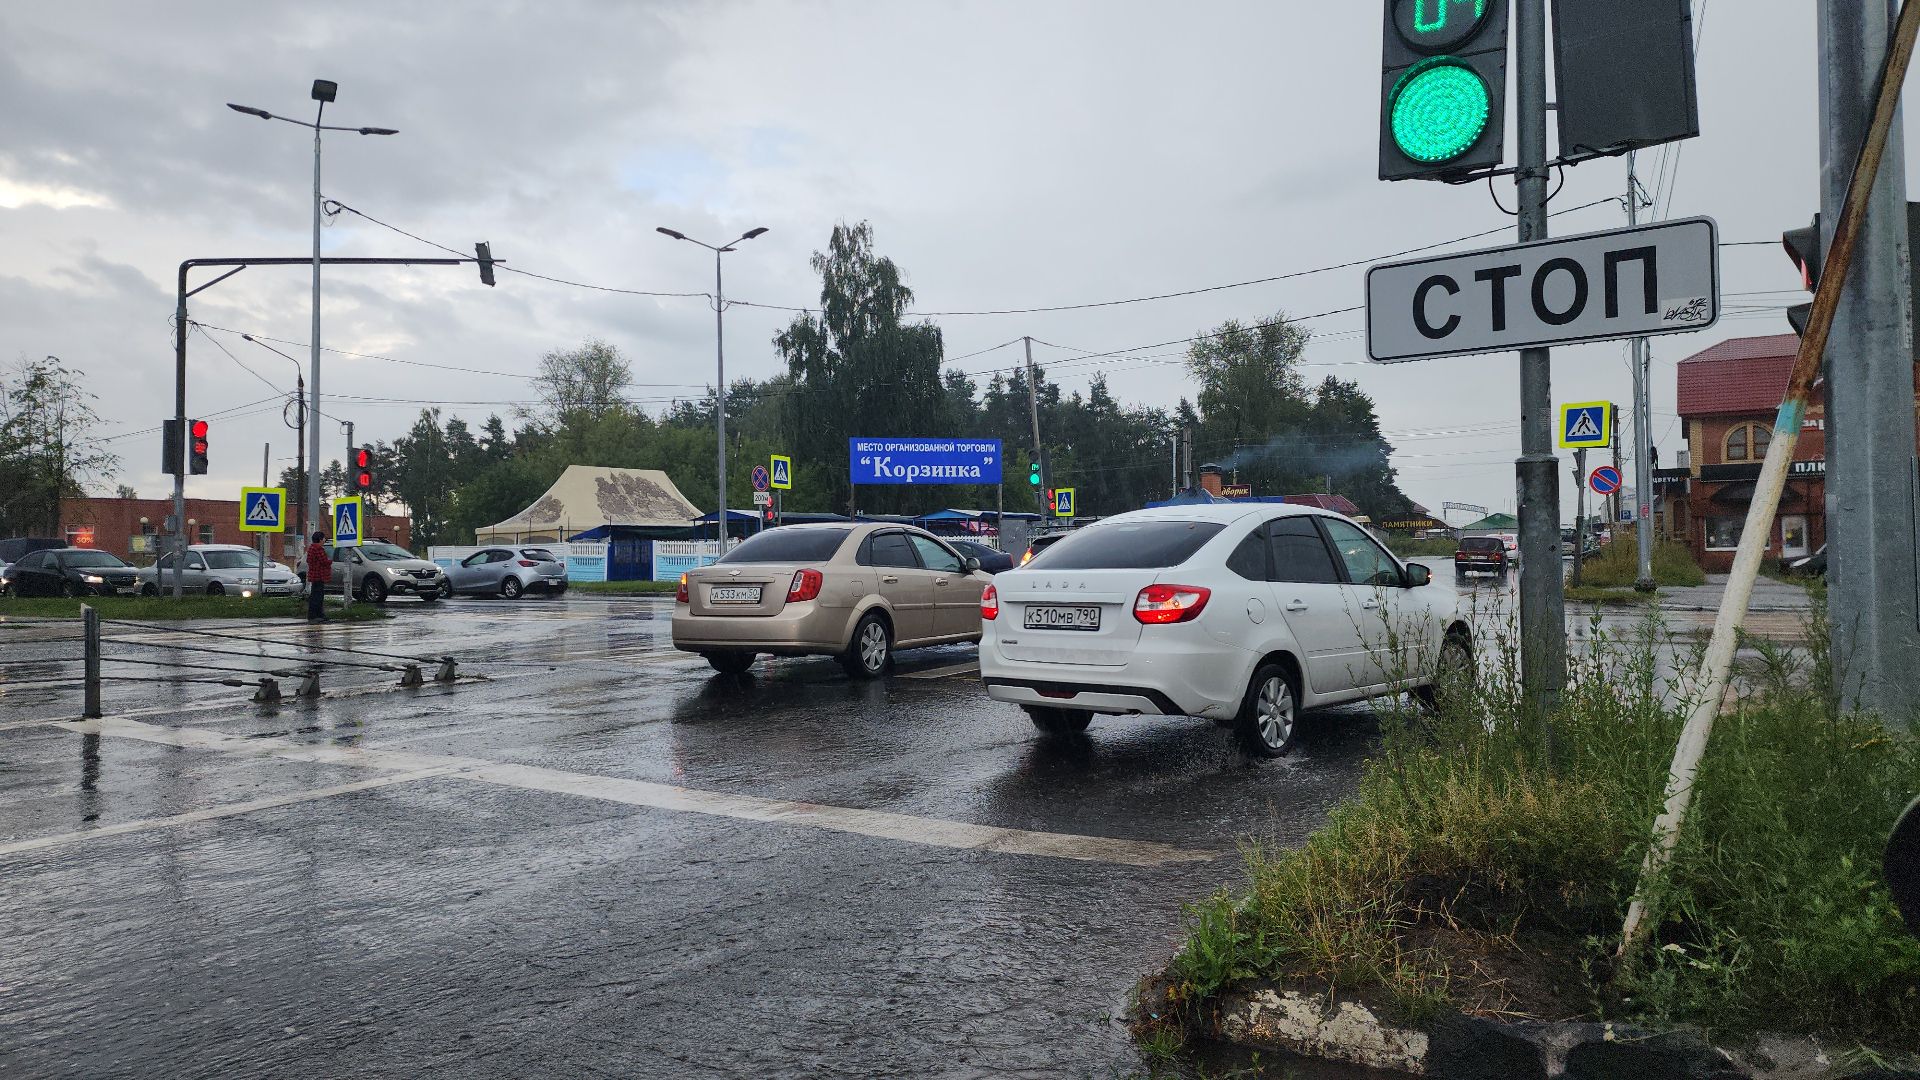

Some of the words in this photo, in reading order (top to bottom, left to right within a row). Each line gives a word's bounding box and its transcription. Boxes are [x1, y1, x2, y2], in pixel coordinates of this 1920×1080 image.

[1413, 245, 1658, 340] СТОП
[857, 442, 884, 452] МЕСТО
[885, 442, 955, 453] ОРГАНИЗОВАННОЙ
[956, 443, 996, 453] ТОРГОВЛИ
[1382, 520, 1433, 529] ПАМЯТНИКИ
[1031, 580, 1087, 589] LADA
